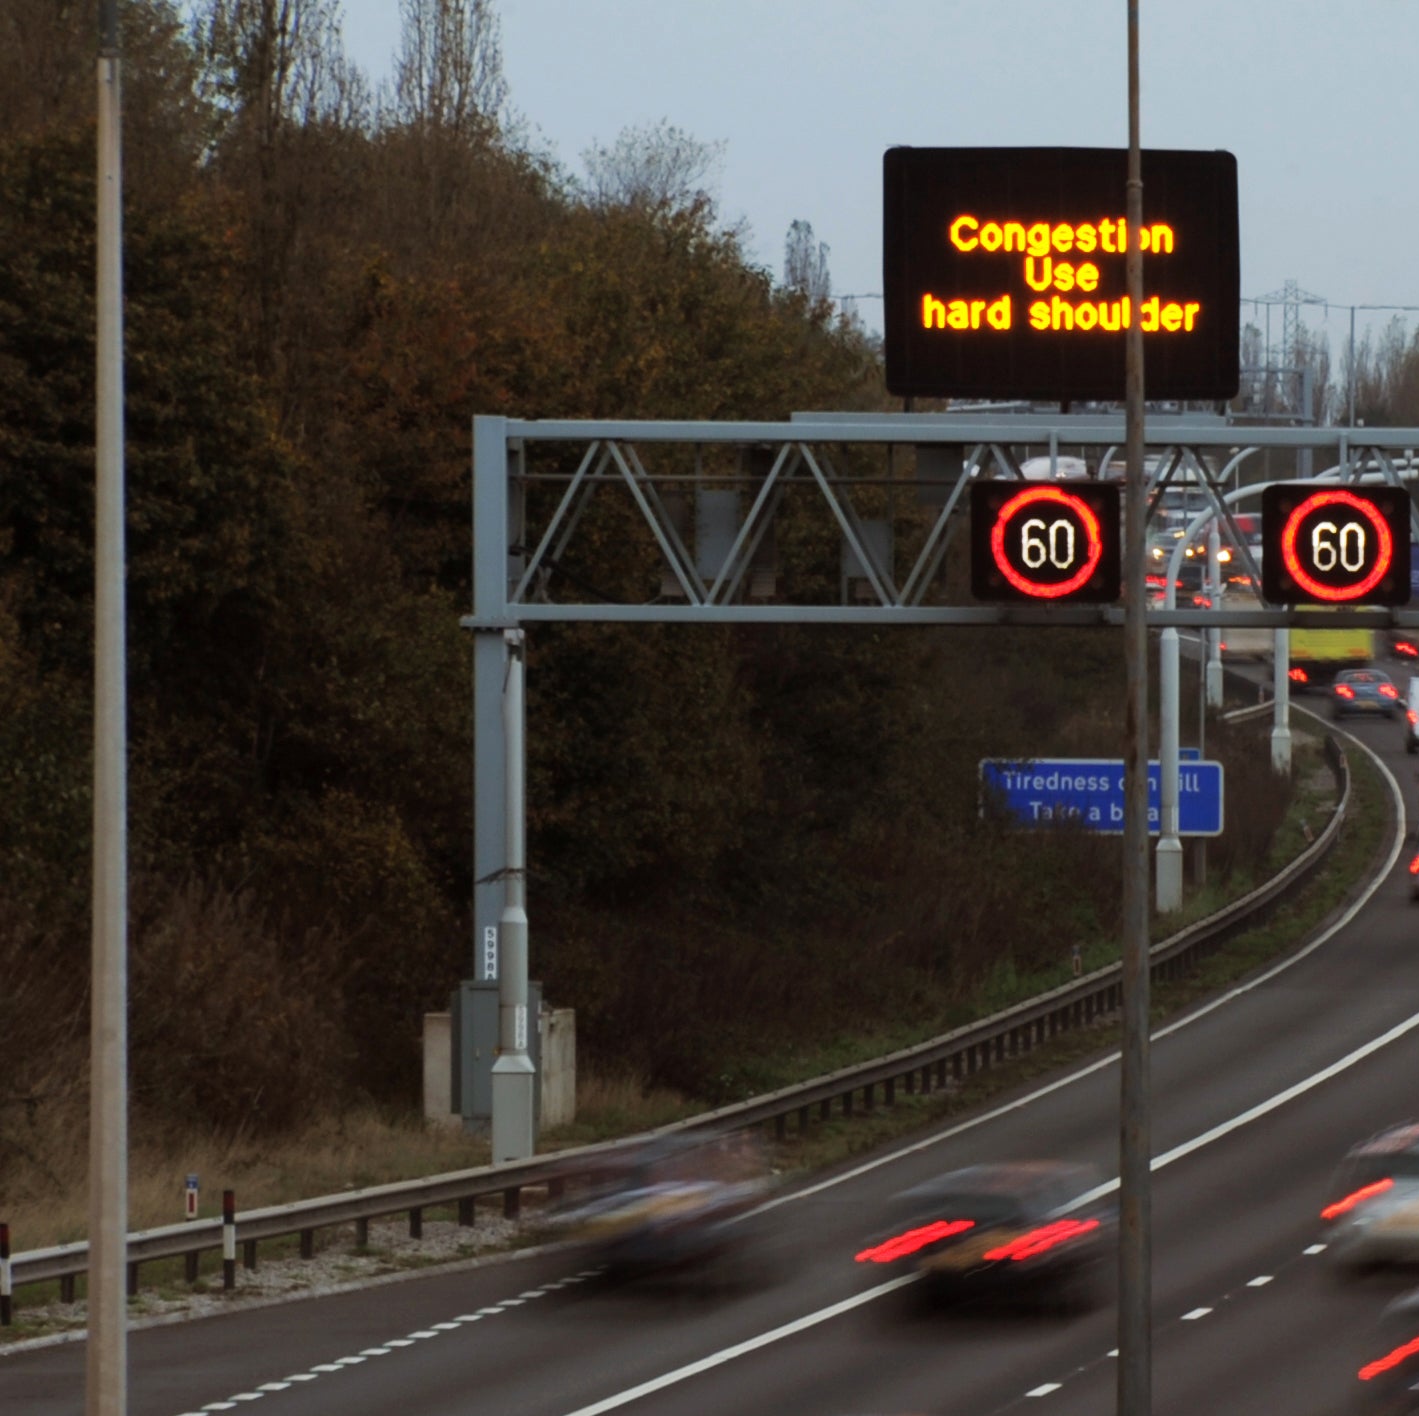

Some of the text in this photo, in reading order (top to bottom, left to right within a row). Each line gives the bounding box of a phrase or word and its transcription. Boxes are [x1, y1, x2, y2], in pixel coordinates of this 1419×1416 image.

[1024, 256, 1100, 292] Use
[922, 293, 1200, 332] hard shoulder
[1020, 518, 1075, 569] 60
[1311, 521, 1366, 572] 60
[1003, 771, 1110, 791] Tiredness
